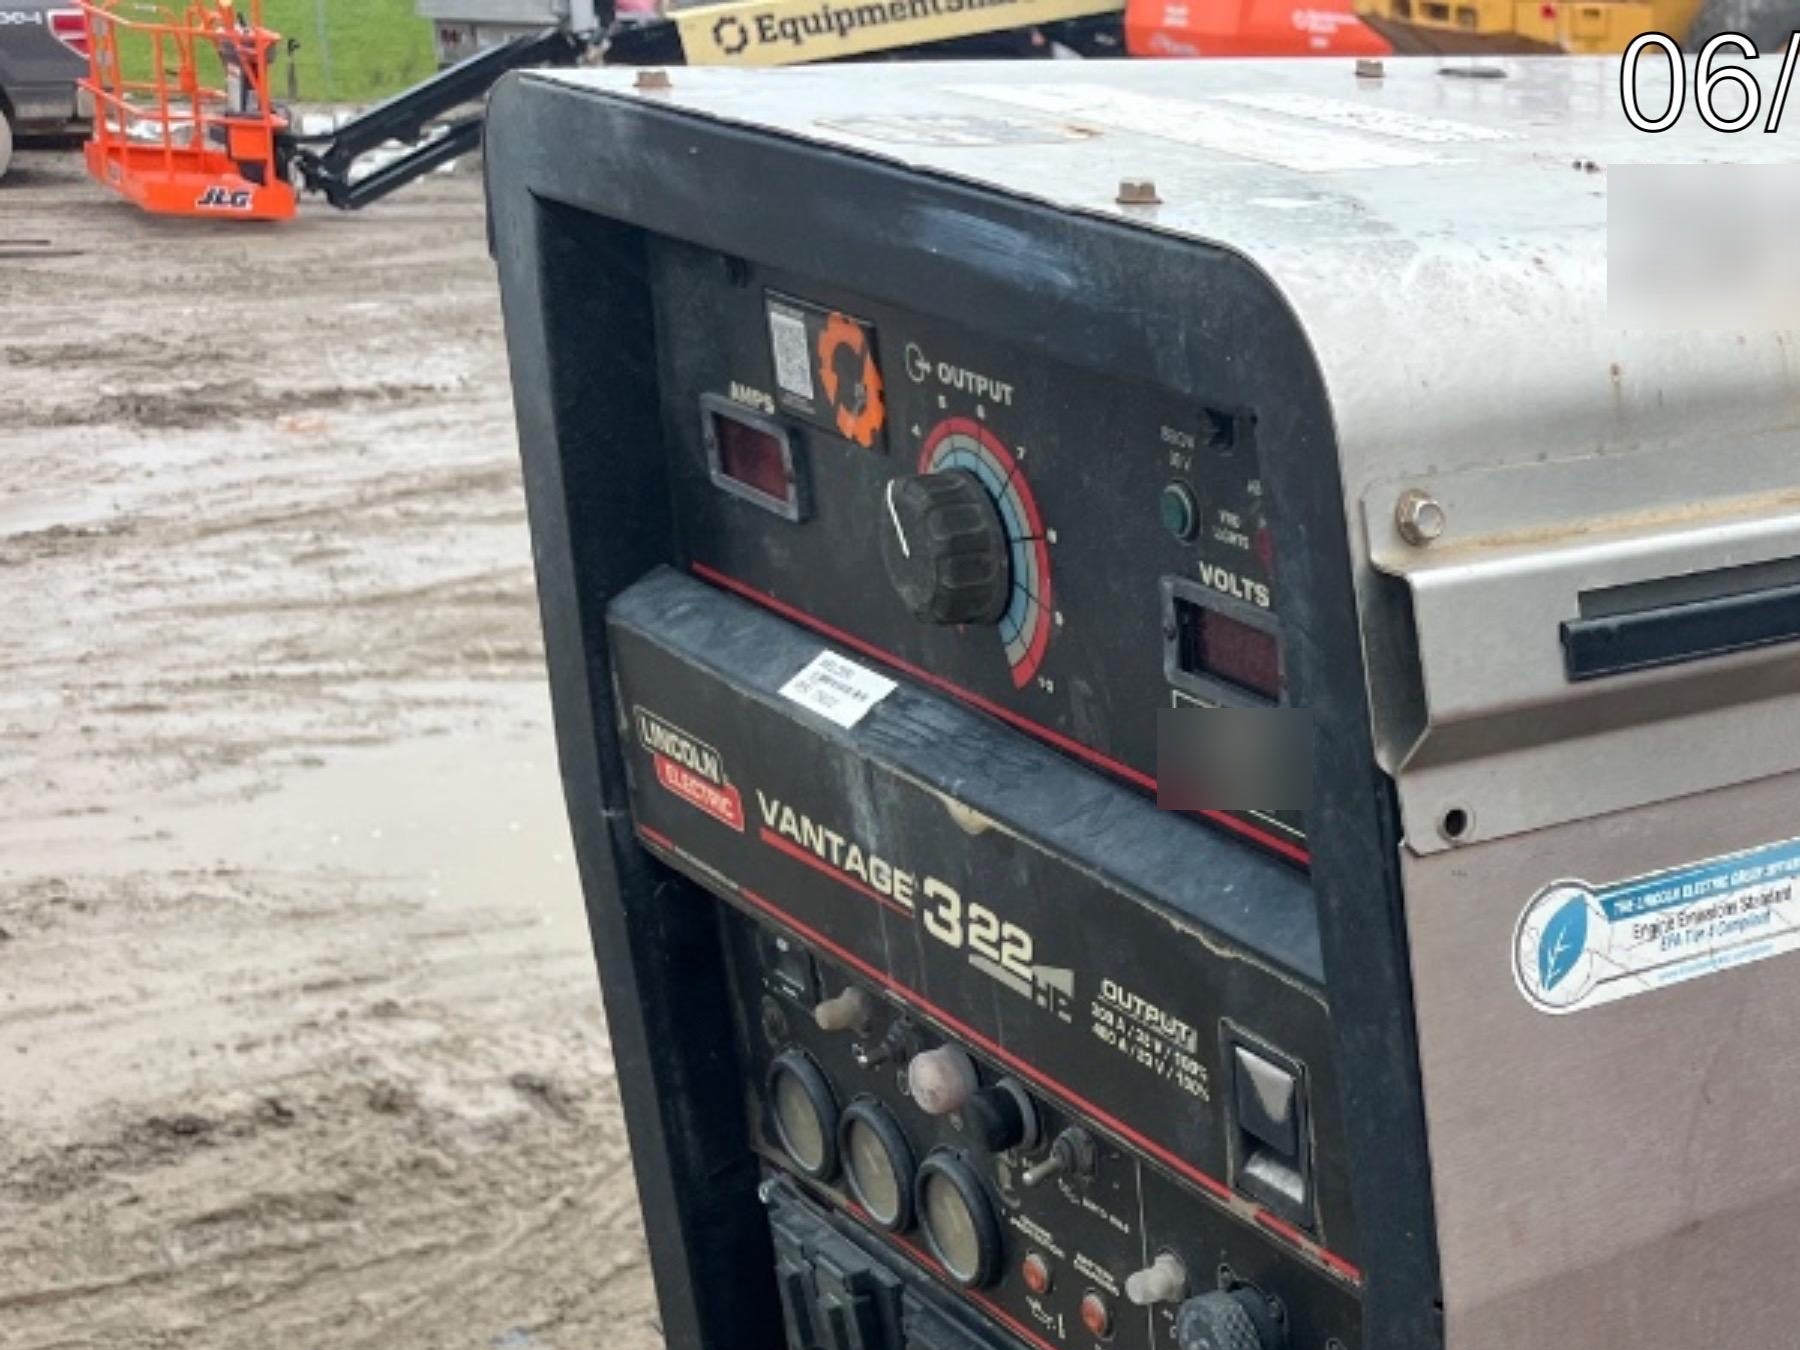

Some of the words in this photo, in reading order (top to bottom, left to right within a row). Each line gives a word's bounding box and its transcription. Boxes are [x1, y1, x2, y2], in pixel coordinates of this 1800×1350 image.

[755, 0, 1036, 44] Equipment
[197, 187, 252, 209] JLG
[730, 381, 775, 415] AMPS
[938, 361, 1014, 406] OUTPUT
[1199, 559, 1270, 609] VOLTS
[639, 715, 721, 785] LINCOLN
[665, 762, 735, 819] ELECTRIC
[756, 788, 915, 908] VANTAGE
[923, 876, 1033, 982] 322
[1633, 916, 1676, 941] Engine
[1740, 884, 1792, 908] Standard
[1101, 977, 1190, 1042] OUTPUT
